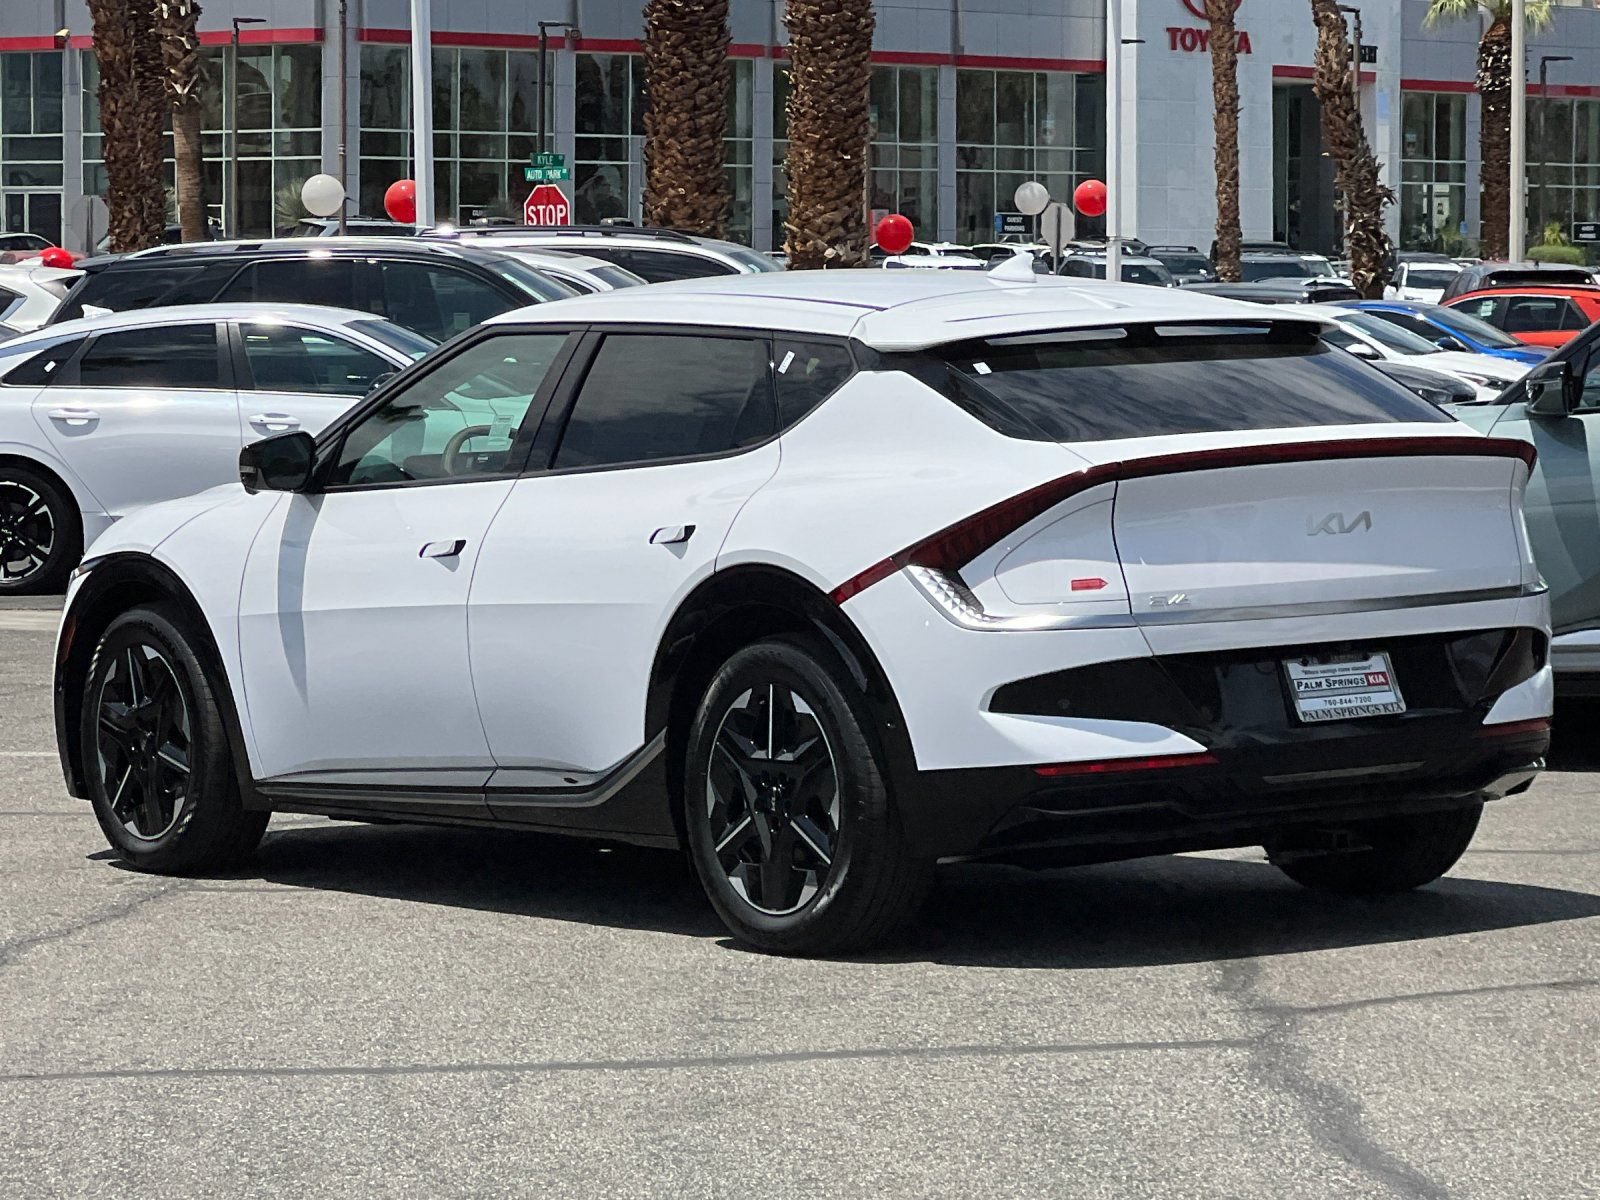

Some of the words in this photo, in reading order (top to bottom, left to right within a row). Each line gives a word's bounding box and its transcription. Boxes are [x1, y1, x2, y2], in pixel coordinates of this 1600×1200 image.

[1165, 27, 1252, 54] TOYA
[537, 155, 554, 165] KYLE
[526, 169, 543, 179] AUTO
[546, 169, 562, 179] PARK
[527, 204, 567, 226] STOP
[1296, 680, 1323, 690] PALM
[1325, 677, 1365, 688] SPRINGS
[1368, 673, 1386, 684] KIA
[1323, 696, 1372, 706] 760-844-7200
[1302, 707, 1333, 721] PALM
[1334, 704, 1381, 718] SPRINGS
[1383, 702, 1404, 713] KIA
